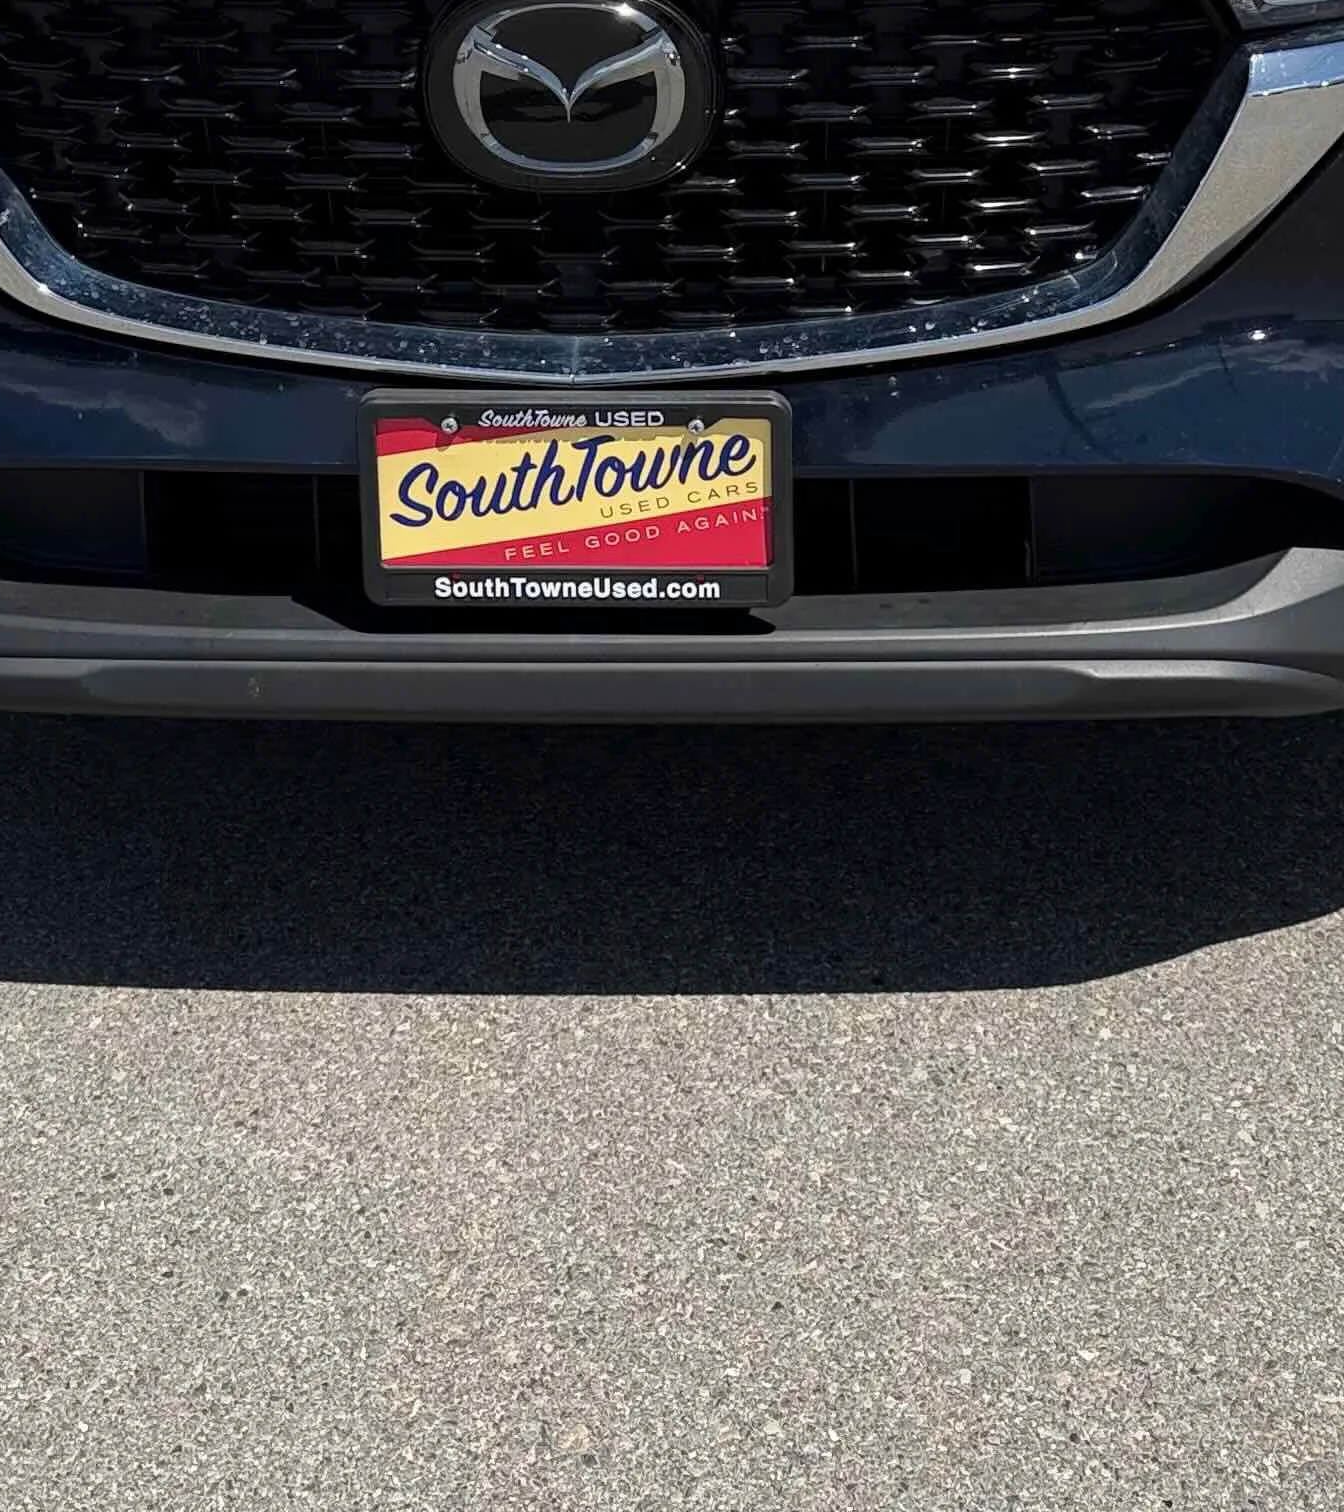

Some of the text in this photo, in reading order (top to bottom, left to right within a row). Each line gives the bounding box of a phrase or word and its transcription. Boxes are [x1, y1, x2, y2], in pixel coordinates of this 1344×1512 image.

[478, 408, 665, 428] SouthTowne USED
[389, 435, 756, 527] SouthTowne
[600, 481, 759, 519] USED CARS
[504, 541, 570, 561] FEEL
[584, 525, 661, 549] GOOD
[434, 576, 721, 599] SouthTowneUsed.com
